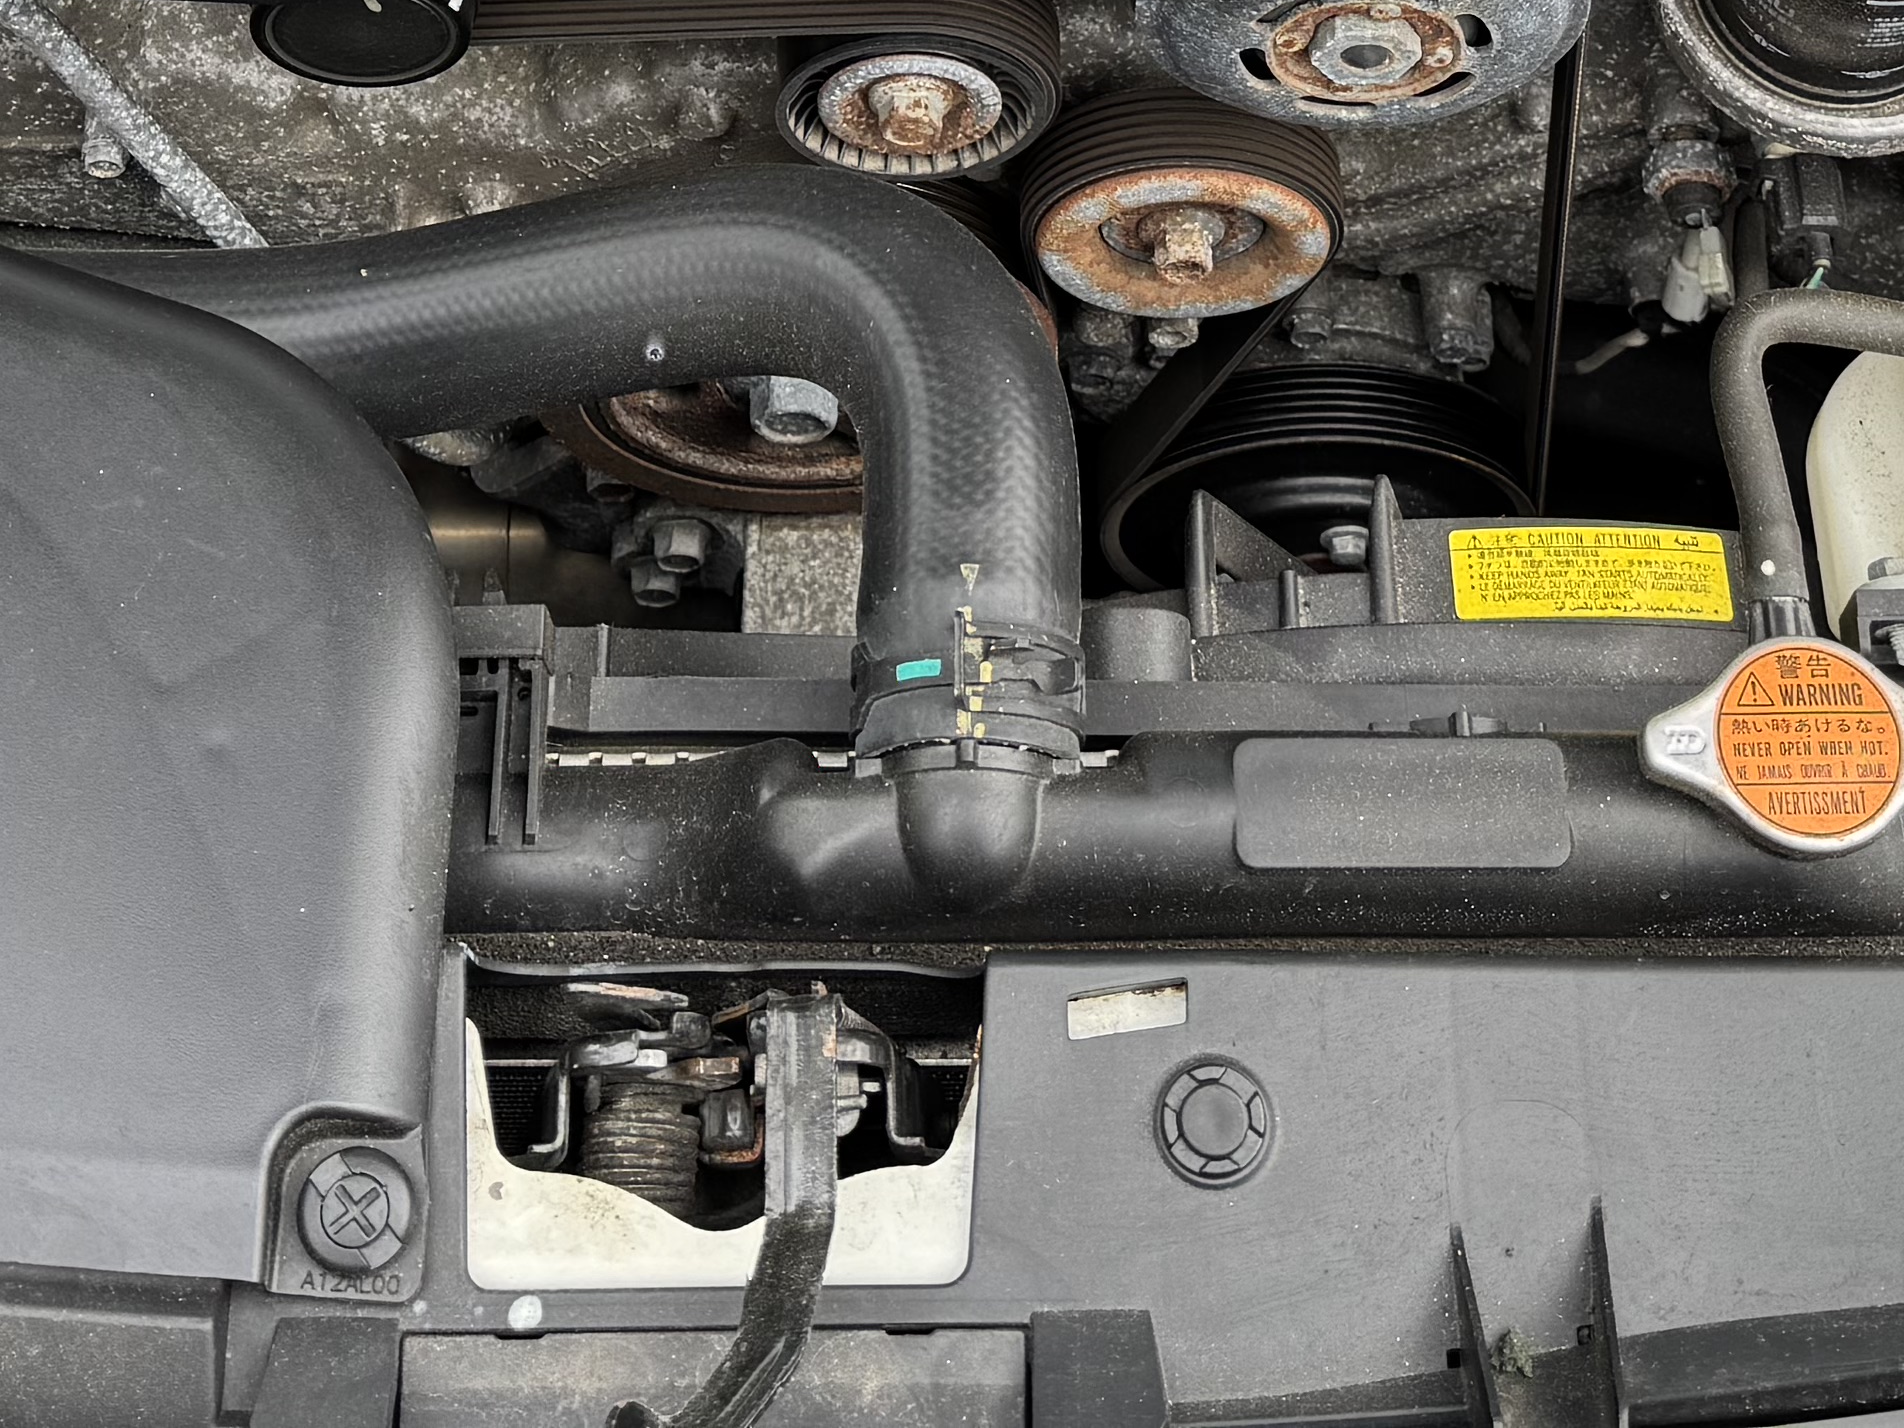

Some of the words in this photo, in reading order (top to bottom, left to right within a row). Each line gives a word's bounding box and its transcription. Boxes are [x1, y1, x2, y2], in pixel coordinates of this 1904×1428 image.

[1527, 532, 1584, 546] CAUTION
[1594, 533, 1661, 547] ATTENTION
[1775, 654, 1831, 679] 警告
[1778, 682, 1864, 708] WARNING
[1731, 717, 1886, 735] 熱い時あけるな。
[1733, 741, 1773, 758] NEVER
[1779, 740, 1812, 756] OPEN
[1818, 740, 1855, 756] WHEN
[1860, 741, 1889, 756] HOT.
[1736, 764, 1749, 780] NE
[1756, 764, 1793, 779] JAMAIS
[1768, 788, 1868, 816] AVERTISSMENT
